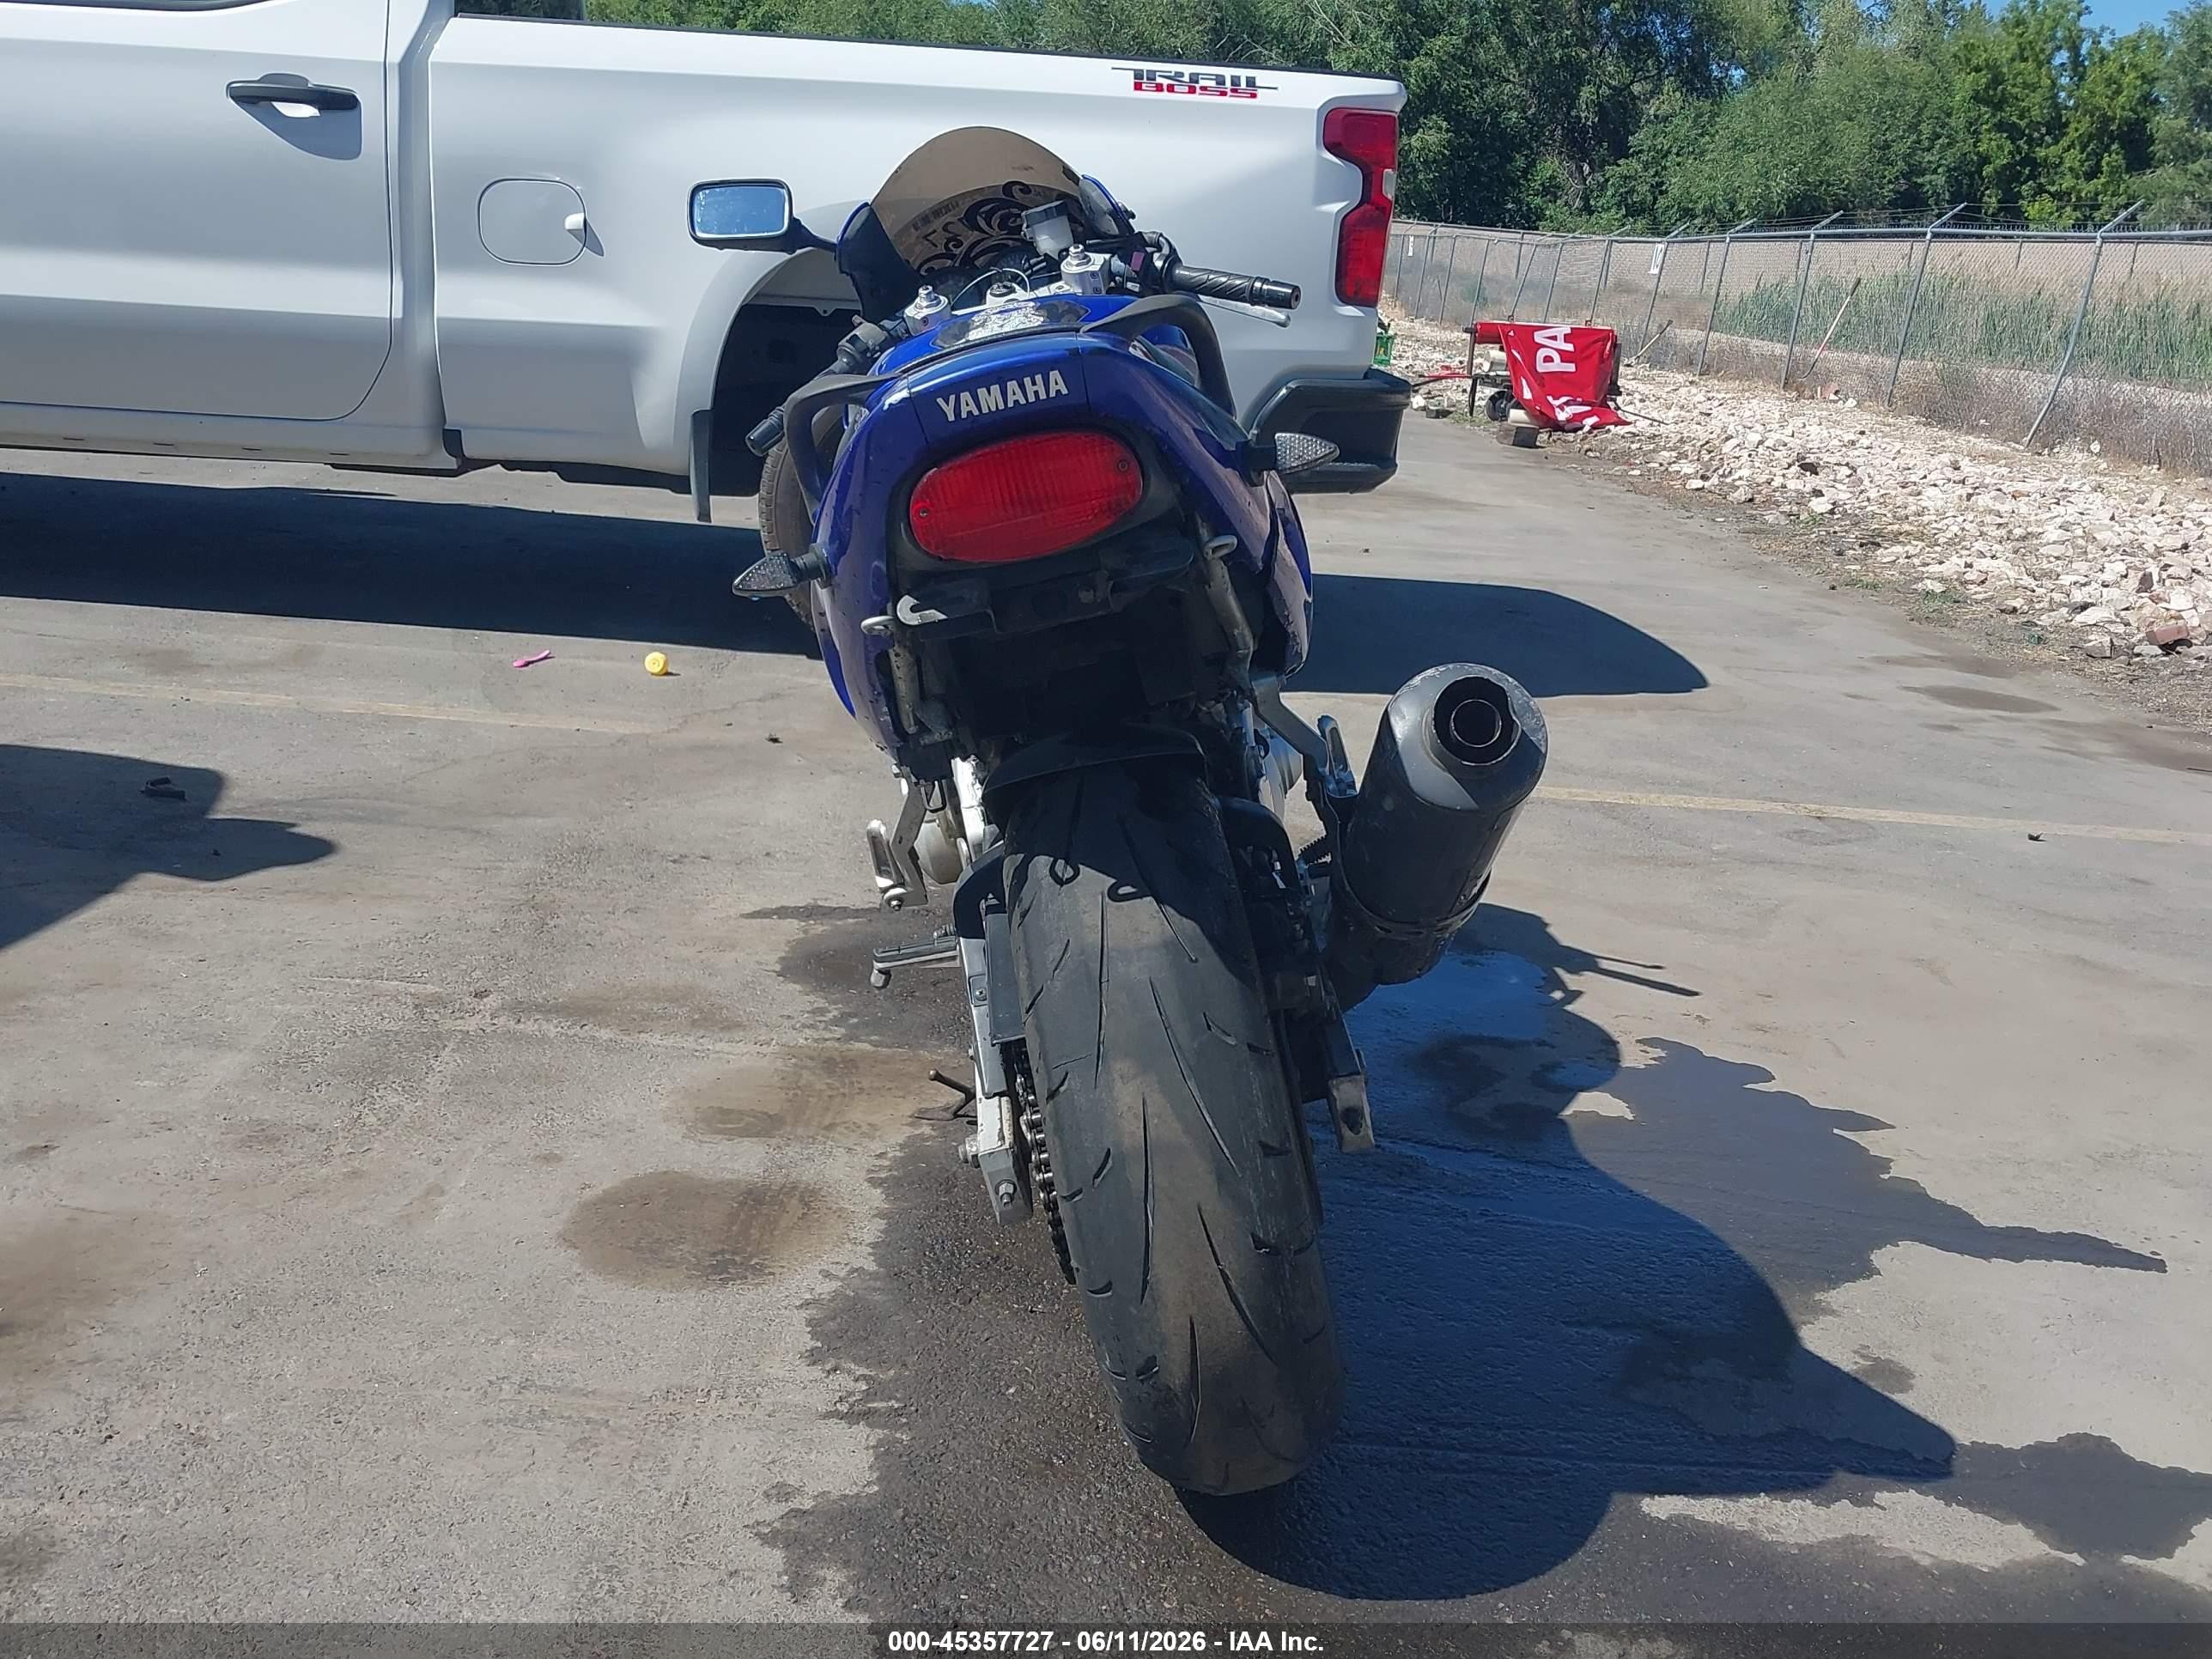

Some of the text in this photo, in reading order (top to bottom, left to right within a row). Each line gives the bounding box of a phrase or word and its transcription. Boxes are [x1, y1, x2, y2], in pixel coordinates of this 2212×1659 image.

[1111, 67, 1279, 89] TRAIL
[1133, 81, 1258, 99] BOSS
[1534, 326, 1577, 373] PA
[936, 369, 1069, 422] YAMAHA
